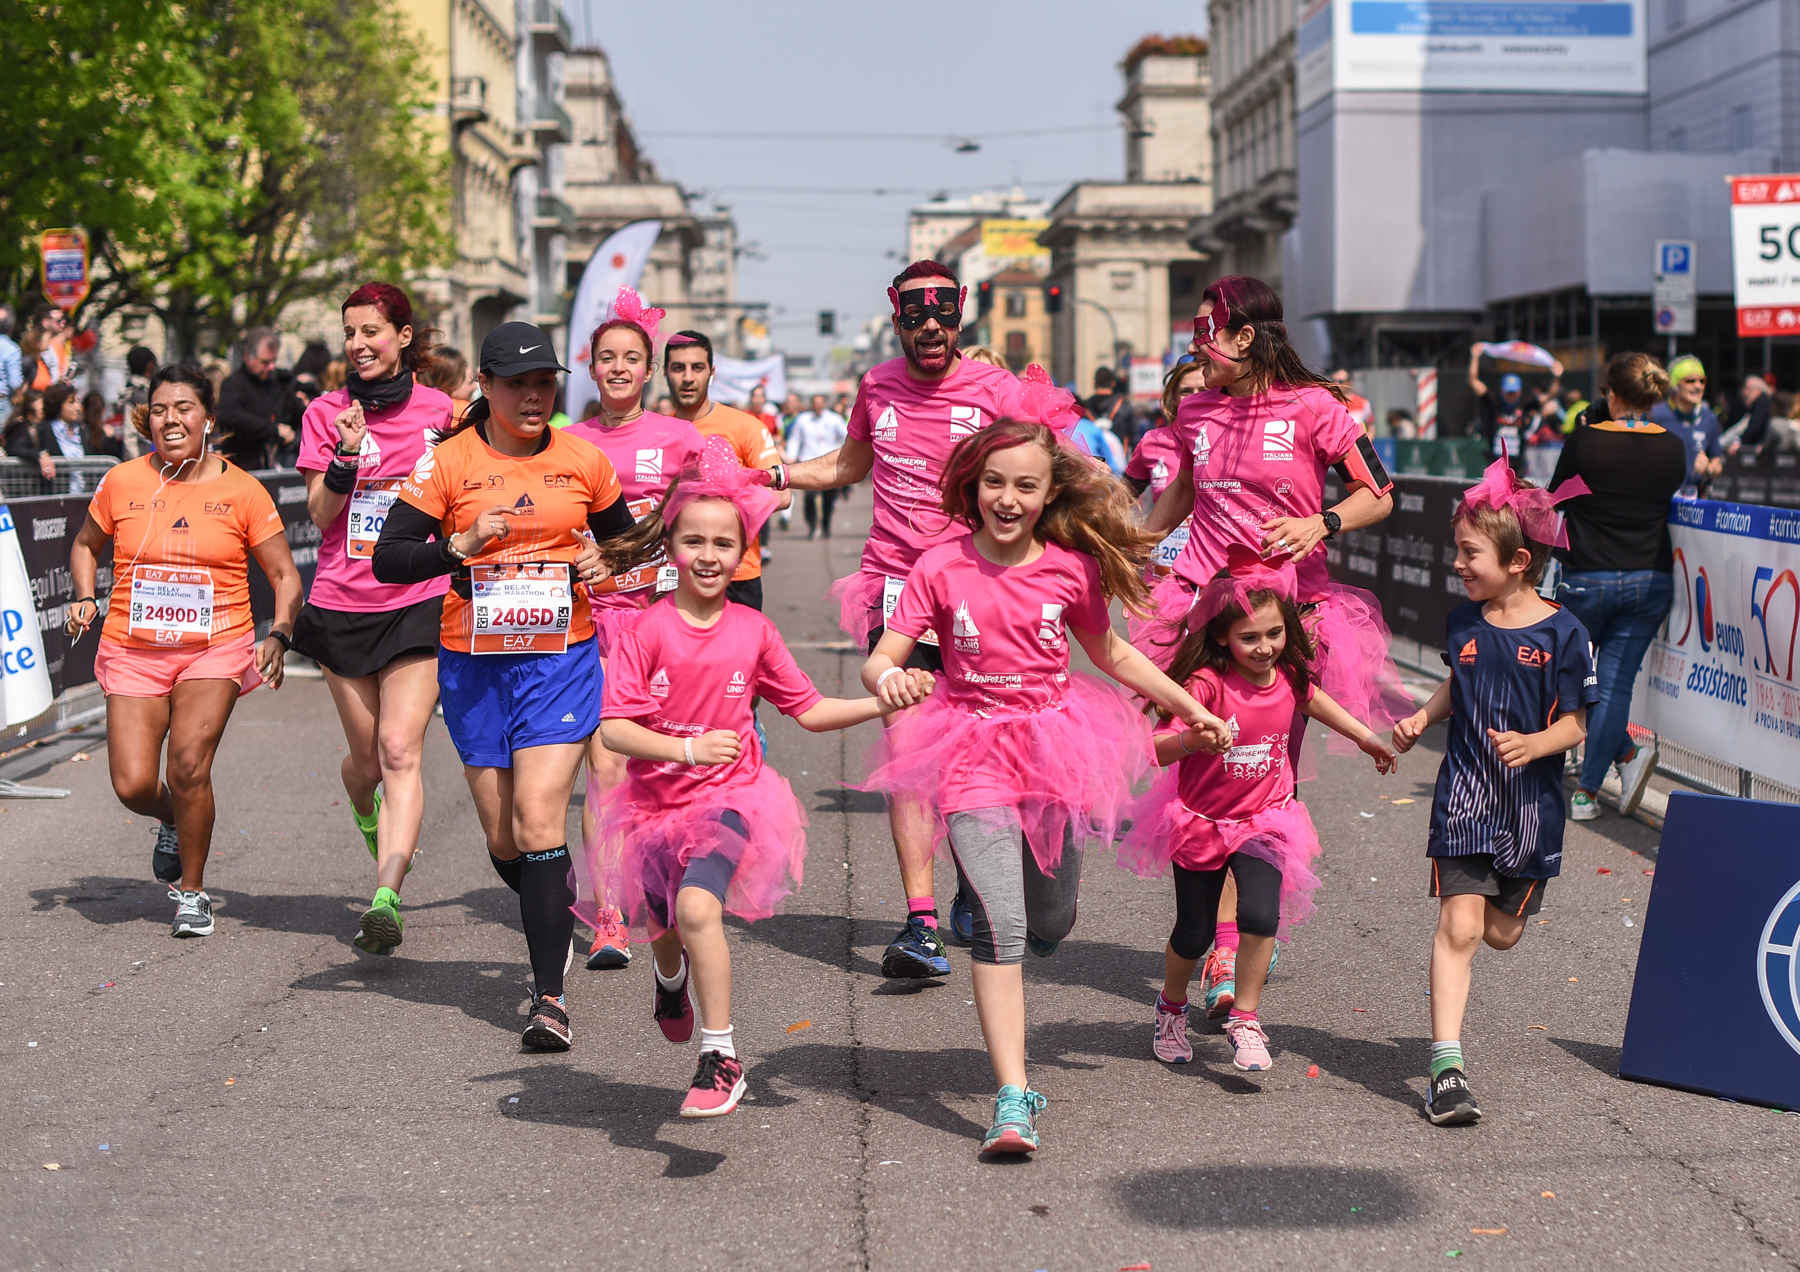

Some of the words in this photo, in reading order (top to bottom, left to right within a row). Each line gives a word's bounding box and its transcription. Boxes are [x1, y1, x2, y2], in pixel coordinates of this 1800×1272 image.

[924, 284, 940, 306] R
[204, 502, 232, 514] EA7
[364, 515, 385, 533] 20
[1715, 505, 1751, 533] #corricon
[1769, 511, 1800, 540] #corrico
[145, 570, 163, 579] EA7
[615, 570, 641, 587] EA7
[145, 605, 198, 623] 2490D
[491, 607, 554, 626] 2405D
[156, 630, 184, 642] EA7
[503, 634, 536, 647] EA7
[954, 637, 980, 649] MILANO
[1716, 621, 1745, 666] europ
[1517, 645, 1552, 664] EA7
[964, 671, 1022, 684] #RUNFOREMMA
[1686, 656, 1748, 707] assistance
[1755, 682, 1775, 711] 1968
[1754, 711, 1760, 725] A
[1760, 713, 1779, 732] PROVA
[1779, 718, 1786, 734] DI
[526, 849, 567, 865] Sable
[1436, 1076, 1457, 1094] ARE
